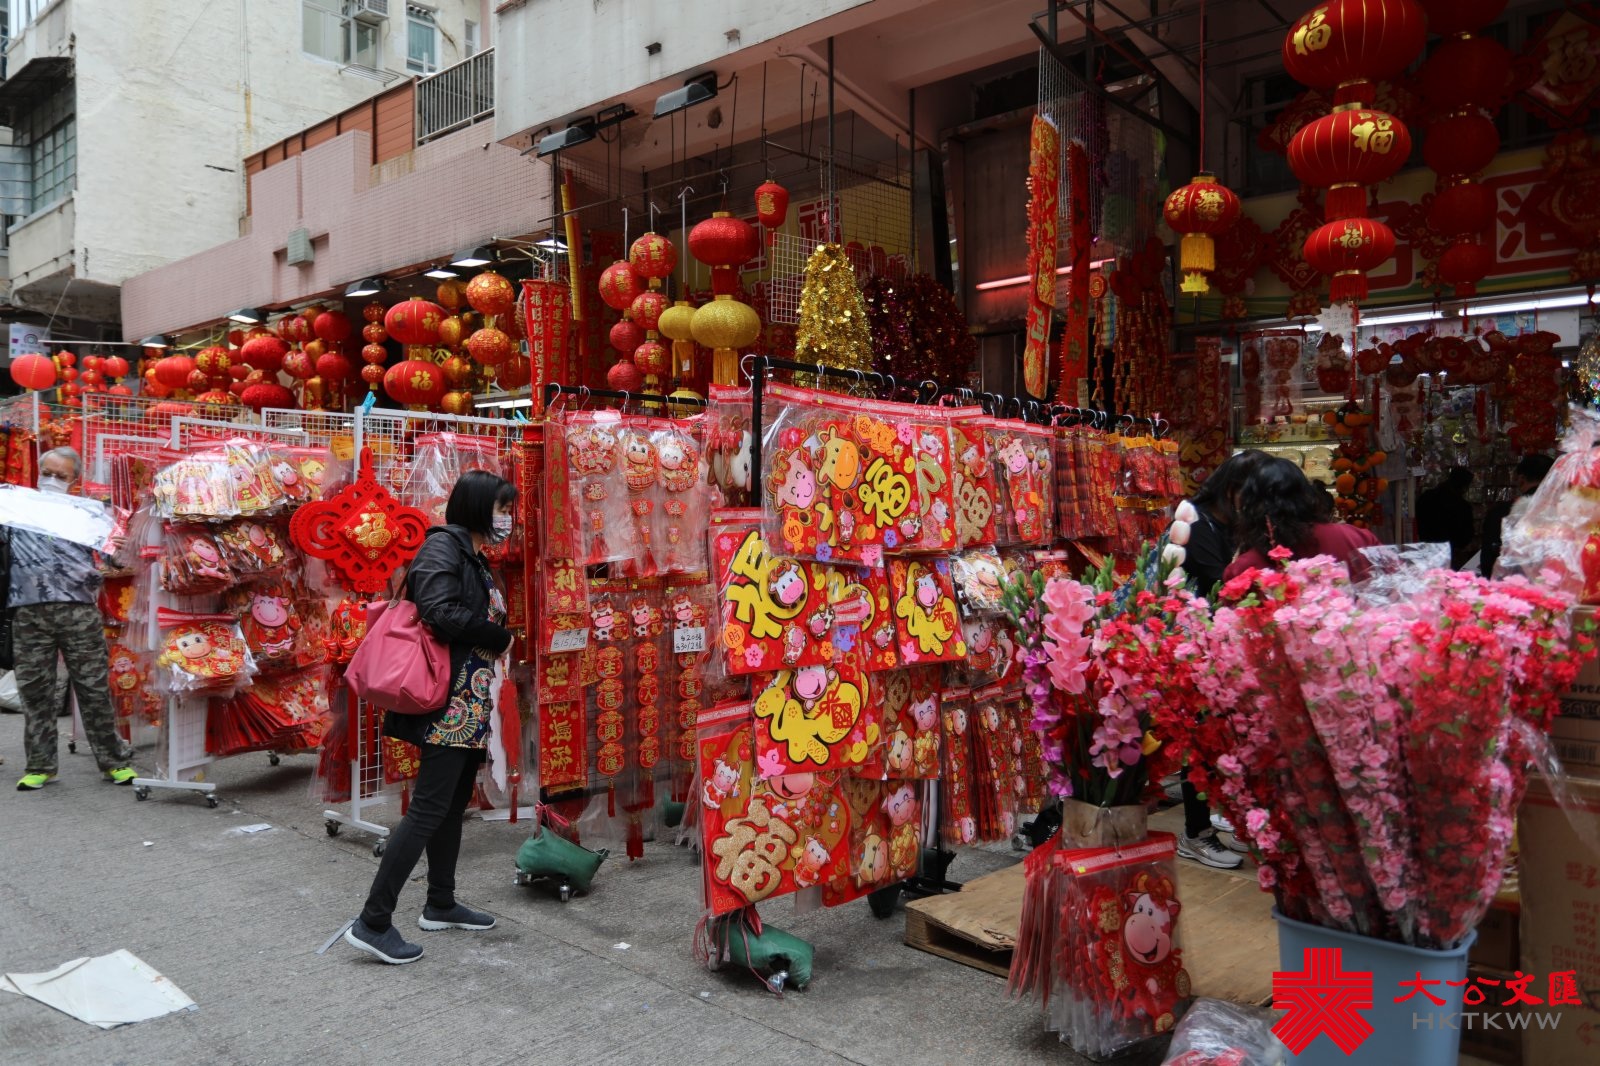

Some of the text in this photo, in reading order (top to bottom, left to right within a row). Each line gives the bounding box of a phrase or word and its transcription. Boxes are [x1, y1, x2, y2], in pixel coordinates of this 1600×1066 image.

[1292, 6, 1332, 56] 福
[1352, 112, 1395, 155] 福
[1340, 229, 1363, 249] 福
[422, 312, 441, 331] 福
[411, 371, 433, 391] 福
[858, 457, 911, 529] 福
[353, 513, 392, 547] 福
